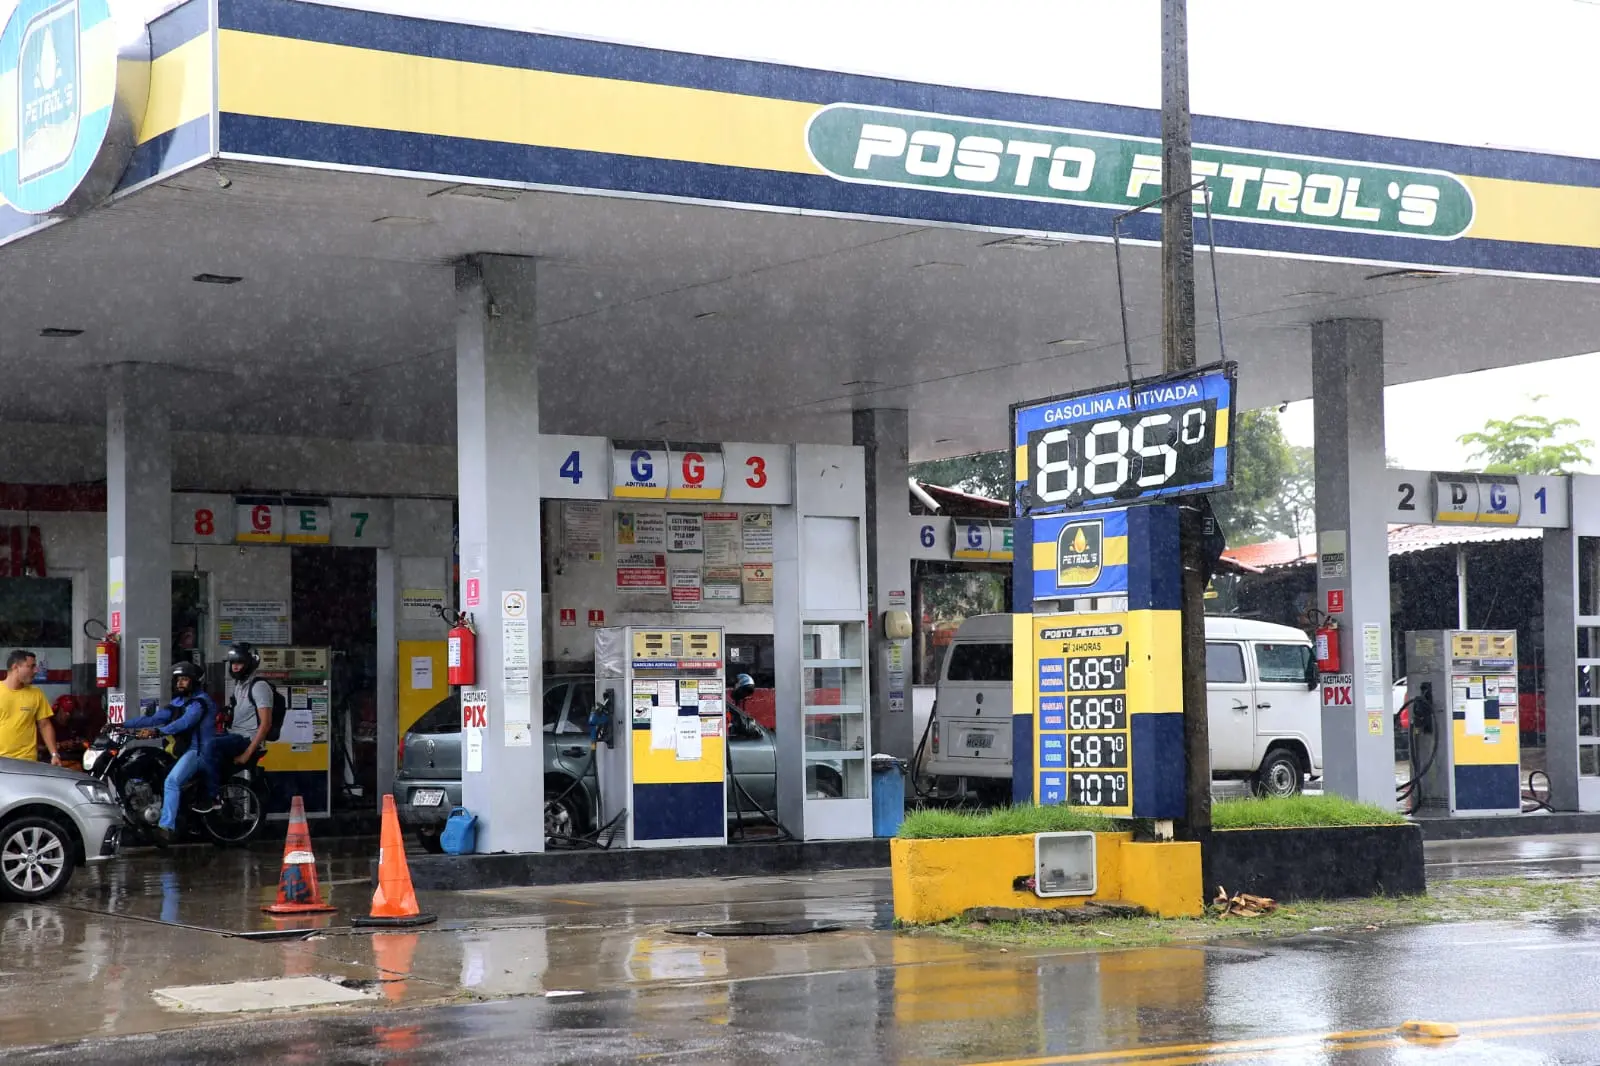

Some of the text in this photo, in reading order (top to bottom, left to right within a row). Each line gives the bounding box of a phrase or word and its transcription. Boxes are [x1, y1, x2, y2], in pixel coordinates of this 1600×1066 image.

[853, 123, 1096, 192] POSTO
[1044, 397, 1114, 423] GASOLINA
[559, 450, 583, 484] 4
[630, 450, 653, 482] G
[682, 452, 705, 484] G
[745, 456, 767, 488] 3
[1397, 483, 1416, 511] 2
[1452, 483, 1468, 505] D
[1490, 484, 1507, 511] G
[1534, 487, 1547, 515] 1
[194, 508, 214, 536] 8
[252, 504, 272, 531] G
[299, 510, 318, 531] E
[350, 513, 369, 537] 7
[920, 525, 935, 548] 6
[967, 522, 982, 548] G
[1003, 529, 1014, 547] E
[1044, 626, 1119, 639] POSTO PETROL'S
[1323, 674, 1352, 685] ACEITAMOS
[463, 691, 487, 702] ACEITAMOS
[1324, 686, 1352, 706] PIX
[109, 705, 124, 723] PIX
[463, 705, 487, 728] PIX
